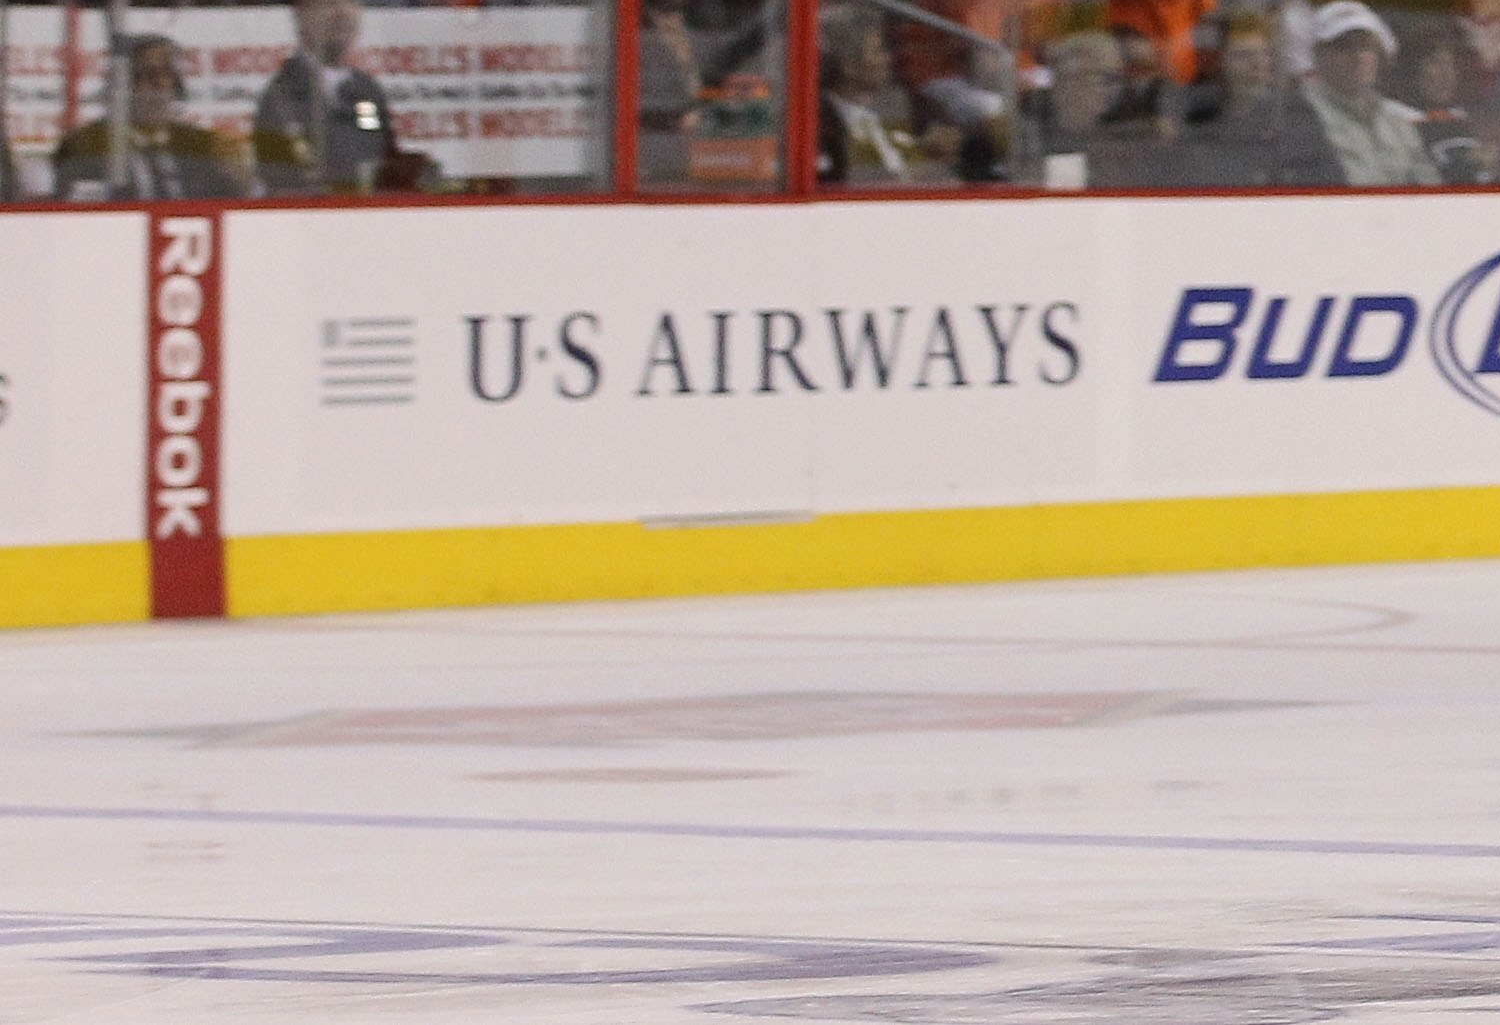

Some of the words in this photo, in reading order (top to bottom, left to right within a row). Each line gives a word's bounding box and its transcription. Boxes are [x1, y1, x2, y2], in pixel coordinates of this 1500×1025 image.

[156, 217, 213, 539] Reebok
[635, 300, 1083, 396] AIRWAYS
[1153, 287, 1420, 381] BUD
